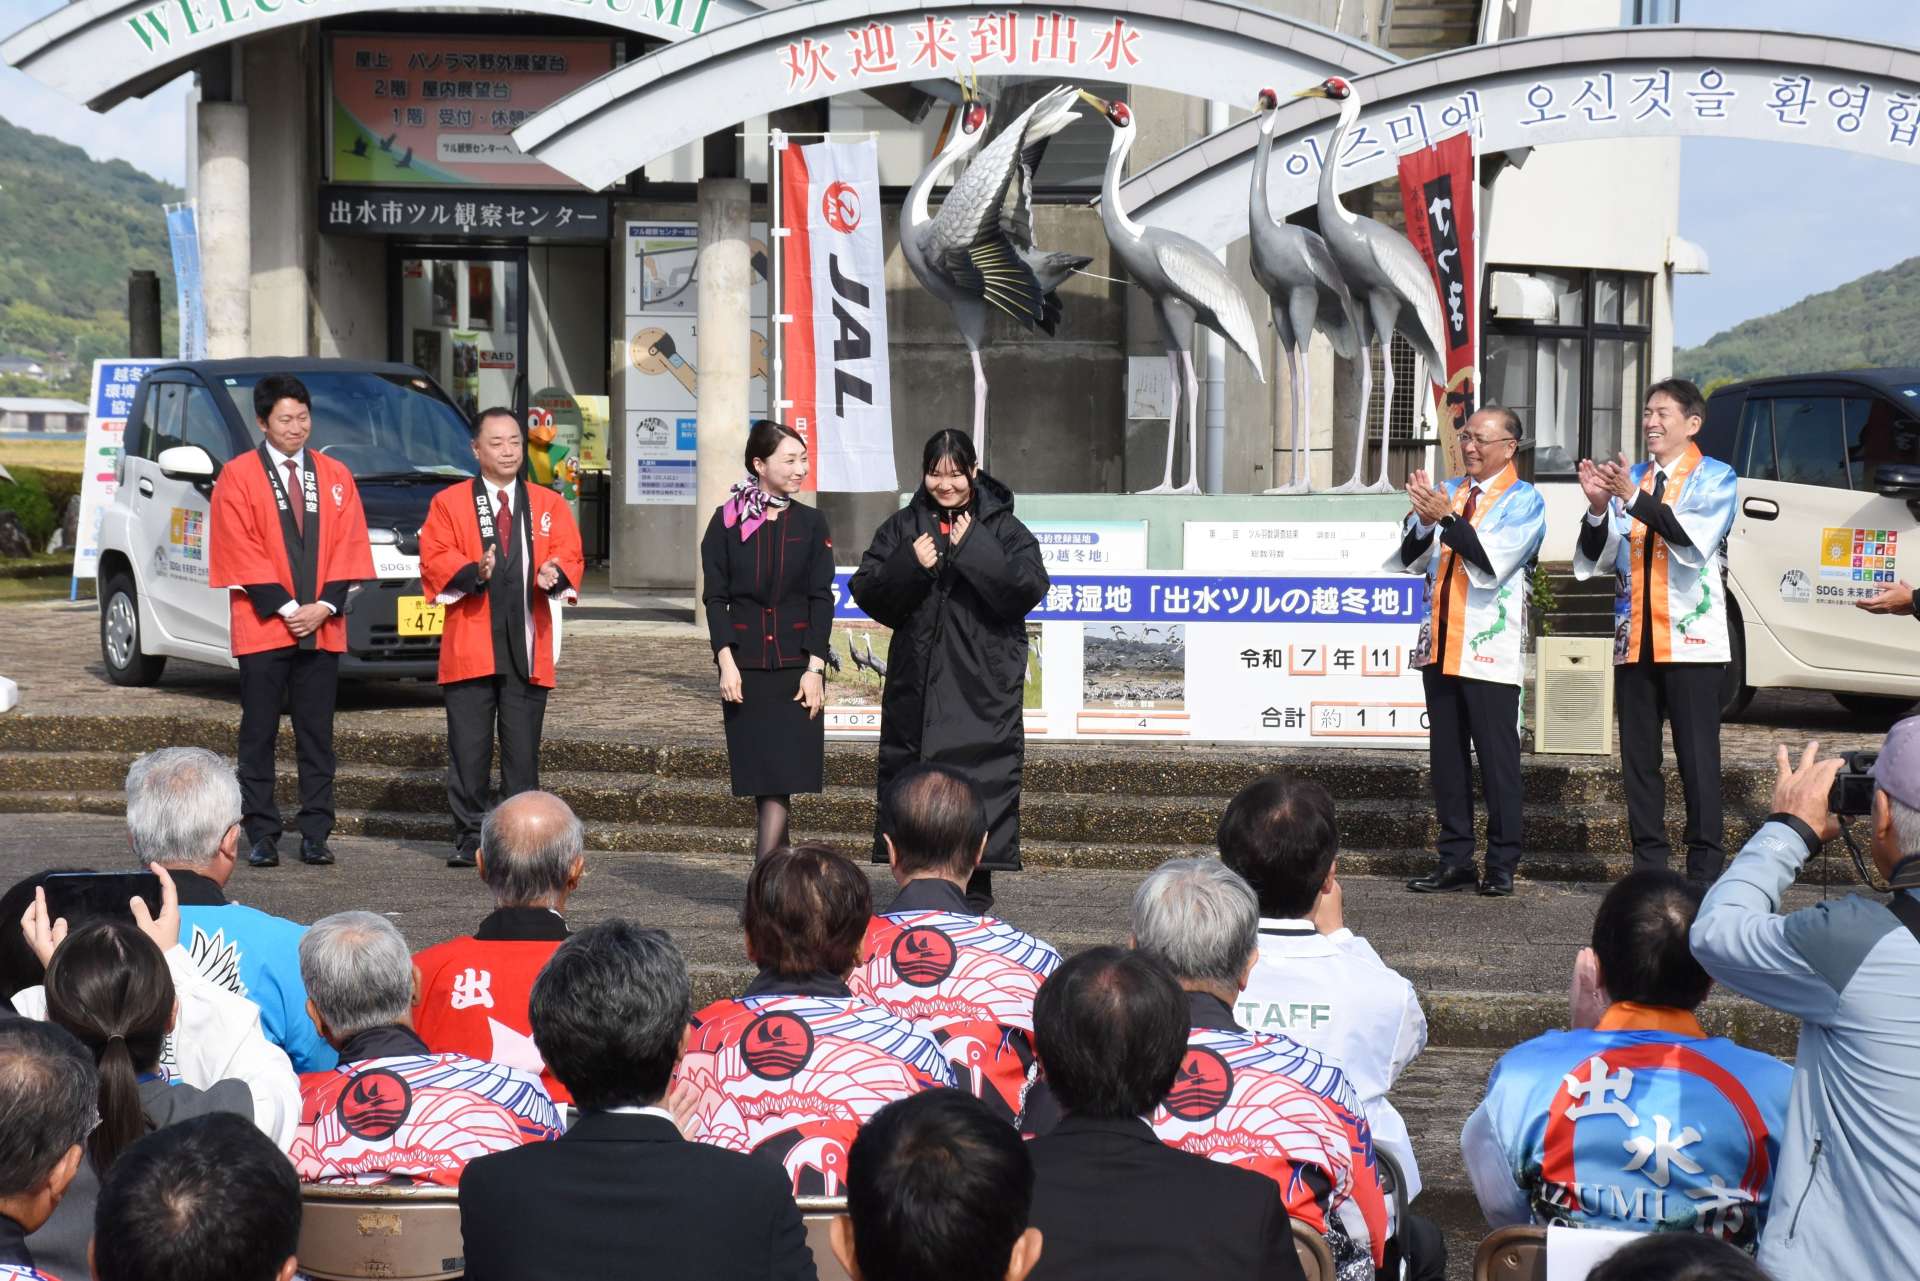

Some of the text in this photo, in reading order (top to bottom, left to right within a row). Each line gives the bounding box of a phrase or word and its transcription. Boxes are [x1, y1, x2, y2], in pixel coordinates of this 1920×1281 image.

[356, 52, 388, 68] 屋上
[777, 11, 1141, 93] 欢迎来到出水
[422, 81, 511, 98] 屋内展望台
[1286, 90, 1483, 175] 이즈미에
[1520, 69, 1735, 125] 오신것을
[329, 200, 598, 227] 出水市ツル観察センター
[827, 194, 837, 226] JAL
[829, 252, 873, 419] JAL
[491, 352, 514, 361] AED
[113, 366, 149, 382] 越冬
[304, 471, 318, 513] 日本航空
[476, 495, 494, 538] 日本航空
[381, 563, 412, 572] SDGs
[1031, 584, 1413, 617] 録湿地「出水ツルの越冬地」
[1816, 585, 1844, 597] SDGs
[1240, 648, 1282, 669] 令和
[1301, 649, 1317, 668] 7
[1333, 648, 1355, 670] 年
[1371, 648, 1390, 668] 11
[1138, 718, 1147, 728] 4
[1261, 706, 1306, 729] 合計
[451, 968, 495, 1010] 出
